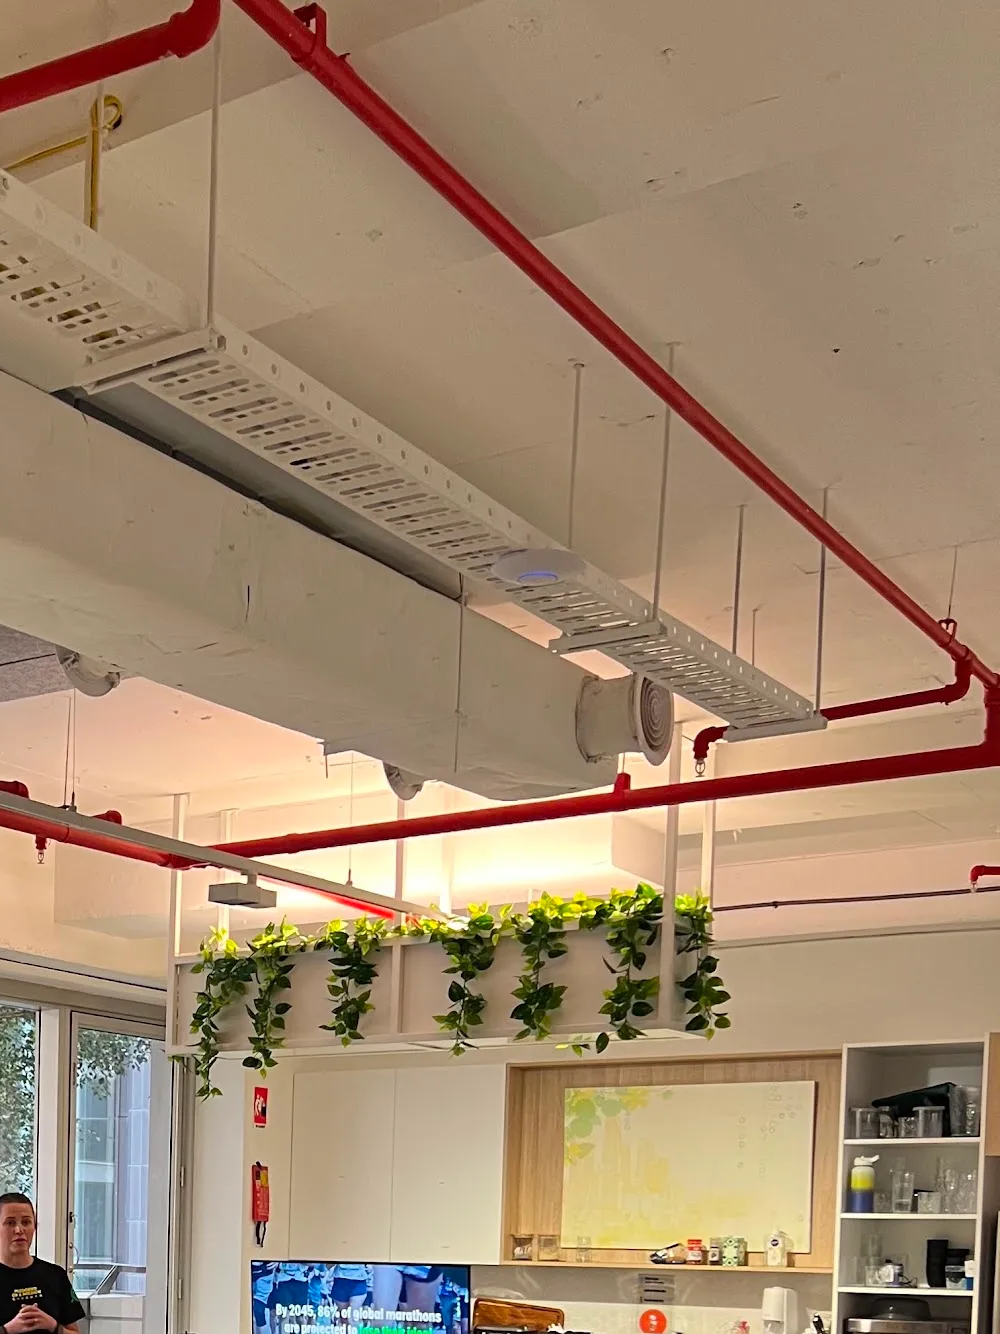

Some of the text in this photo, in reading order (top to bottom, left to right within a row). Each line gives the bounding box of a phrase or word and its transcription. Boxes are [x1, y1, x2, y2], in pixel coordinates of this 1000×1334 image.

[276, 1303, 442, 1323] By 2045, 86% of global marathons
[284, 1324, 300, 1334] are
